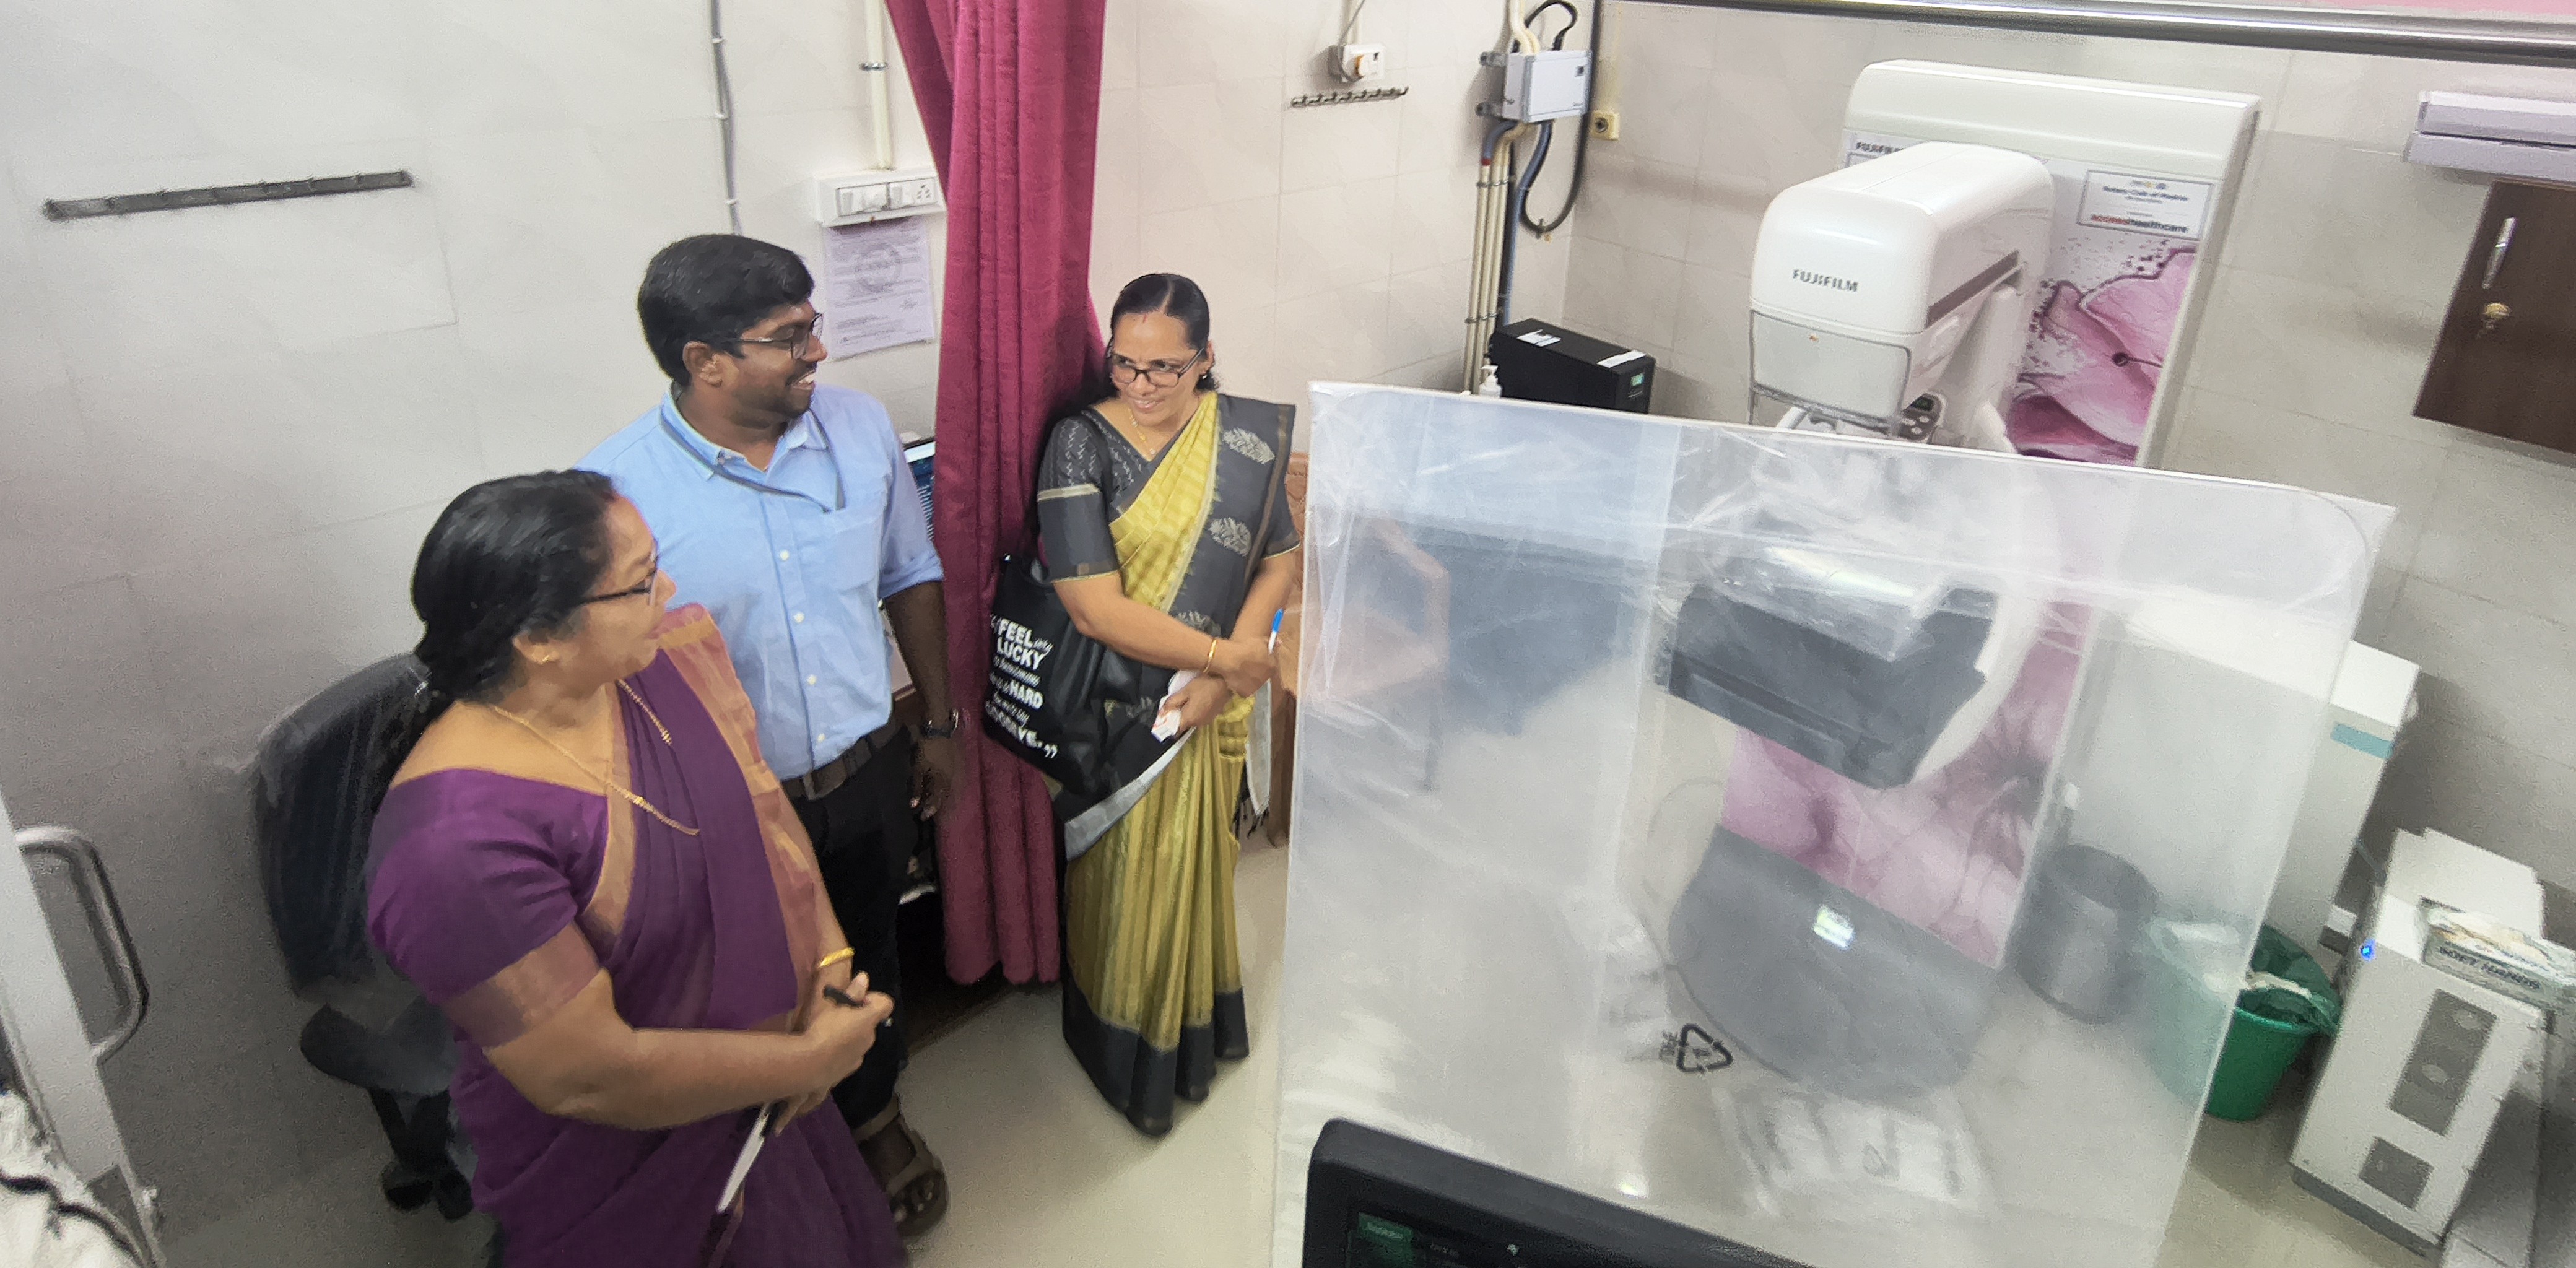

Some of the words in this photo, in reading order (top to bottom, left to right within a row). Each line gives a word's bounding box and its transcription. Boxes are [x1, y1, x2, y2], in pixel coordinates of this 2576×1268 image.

[1793, 269, 1858, 292] FUJIFILM
[998, 618, 1033, 648] FEEL
[997, 636, 1045, 670] LUCKY
[1009, 679, 1043, 710] HARD
